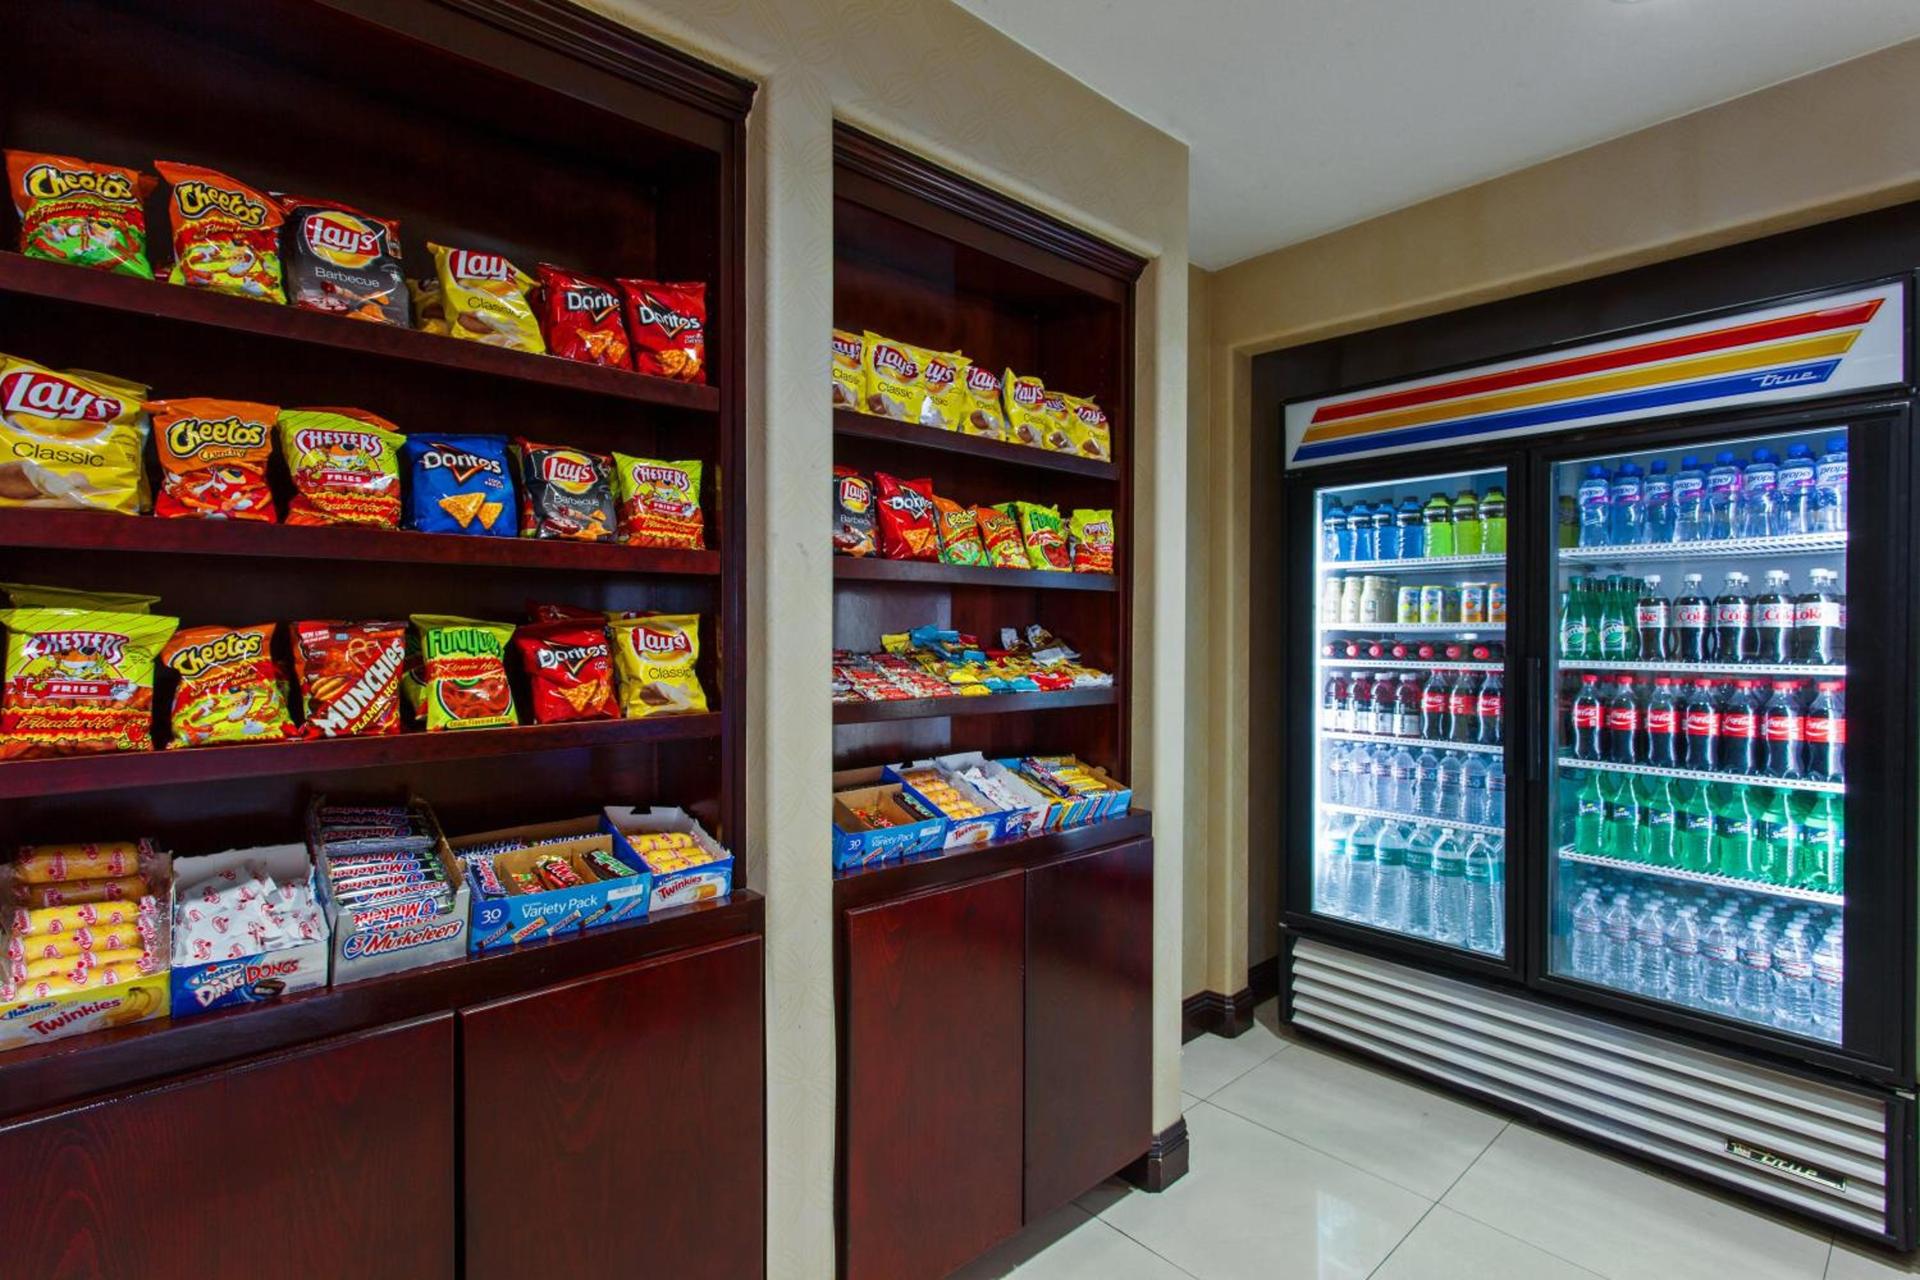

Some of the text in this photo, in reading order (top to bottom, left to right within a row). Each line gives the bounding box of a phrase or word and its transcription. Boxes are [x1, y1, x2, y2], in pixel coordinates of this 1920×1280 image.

[26, 165, 134, 201] Cheetos
[177, 180, 266, 227] Cheetos
[315, 266, 380, 288] Barbecue
[639, 305, 700, 330] Doritos
[877, 381, 914, 400] Classic
[1751, 371, 1817, 387] True
[168, 417, 266, 457] Cheetos
[12, 441, 105, 468] Classic
[422, 451, 502, 475] Doritos
[326, 474, 362, 483] FRIES
[173, 633, 262, 677] Cheetos
[538, 643, 608, 669] Doritos
[648, 666, 692, 680] Classic
[51, 684, 99, 694] FRIES
[658, 876, 703, 899] Twinkies
[481, 895, 598, 925] 30 Variety Pack
[351, 936, 366, 950] 3
[365, 922, 459, 954] Musketeers
[246, 958, 299, 983] DONGS
[28, 998, 122, 1036] Twinkies
